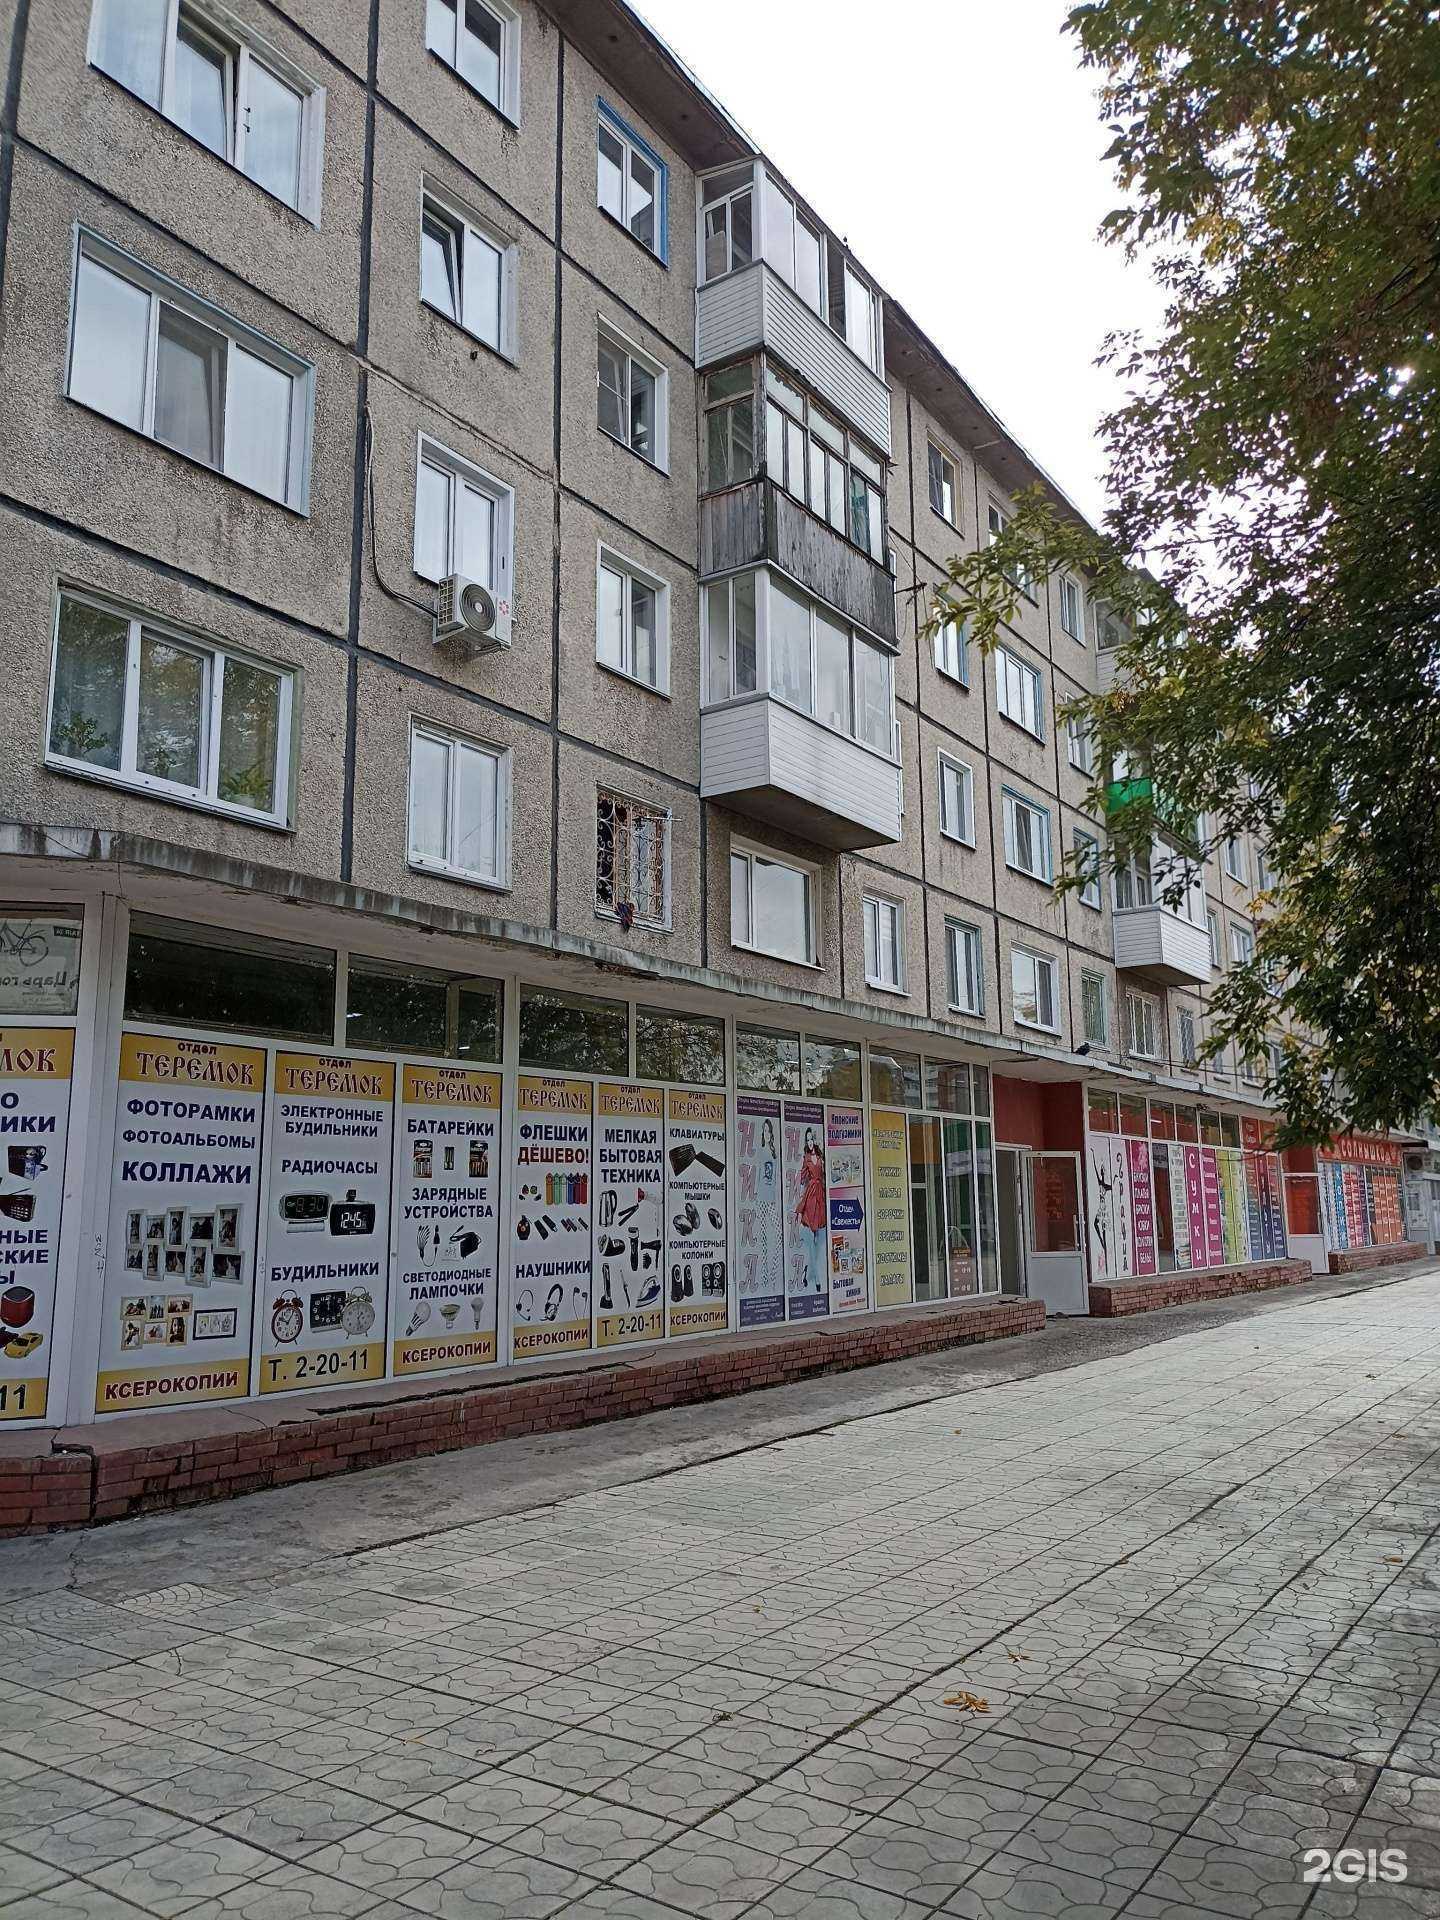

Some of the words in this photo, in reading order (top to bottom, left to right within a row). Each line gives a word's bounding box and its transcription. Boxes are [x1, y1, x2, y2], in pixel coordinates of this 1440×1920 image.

[136, 1052, 255, 1086] ТЕРЕМОК
[285, 1067, 384, 1096] ТЕРЕМОК
[411, 1079, 493, 1104] ТЕРЕМОК
[519, 1087, 588, 1111] ТЕРЕМОК
[126, 1098, 256, 1123] ФОТОРАМКИ
[280, 1104, 384, 1122] ЭЛЕКТРОННЫЕ
[601, 1094, 661, 1115] ТЕРЕМОК
[672, 1099, 724, 1119] ТЕРЕМОК
[284, 1121, 379, 1138] БУДИЛЬНИКИ
[407, 1118, 494, 1137] БАТАРЕЙКИ
[519, 1123, 588, 1142] ФЛЕШКИ
[604, 1128, 657, 1144] МЕЛКАЯ
[669, 1127, 725, 1142] КЛАВИАТУРЫ
[122, 1129, 256, 1149] ФОТОАЛЬБОМЫ
[517, 1144, 589, 1165] ДЁШЕВО!
[599, 1148, 662, 1164] БЫТОВАЯ
[121, 1160, 252, 1184] КОЛЛАЖИ
[281, 1159, 378, 1176] РАДИОЧАСЫ
[600, 1168, 661, 1184] ТЕХНИКА
[412, 1187, 487, 1202] ЗАРЯДНЫЕ
[669, 1181, 725, 1192] КОМПЬЮТЕРНЫЕ
[684, 1191, 711, 1201] МЫШКИ
[404, 1204, 494, 1220] УСТРОЙСТВА
[669, 1239, 726, 1250] КОМПЬЮТЕРНЫЕ
[681, 1250, 714, 1260] КОЛОНКИ
[270, 1262, 380, 1283] БУДИЛЬНИКИ
[402, 1267, 492, 1285] СВЕТОДИОДНЫЕ
[515, 1260, 591, 1279] НАУШНИКИ
[408, 1282, 485, 1301] ЛАМПОЧКИ
[618, 1313, 662, 1335] 2-20-11
[670, 1311, 726, 1326] КСЕРОКОПИИ
[514, 1328, 589, 1349] КСЕРОКОПИИ
[402, 1341, 492, 1364] КСЕРОКОПИИ
[295, 1349, 369, 1379] 2-20-11
[104, 1371, 239, 1401] КСЕРОКОПИИ
